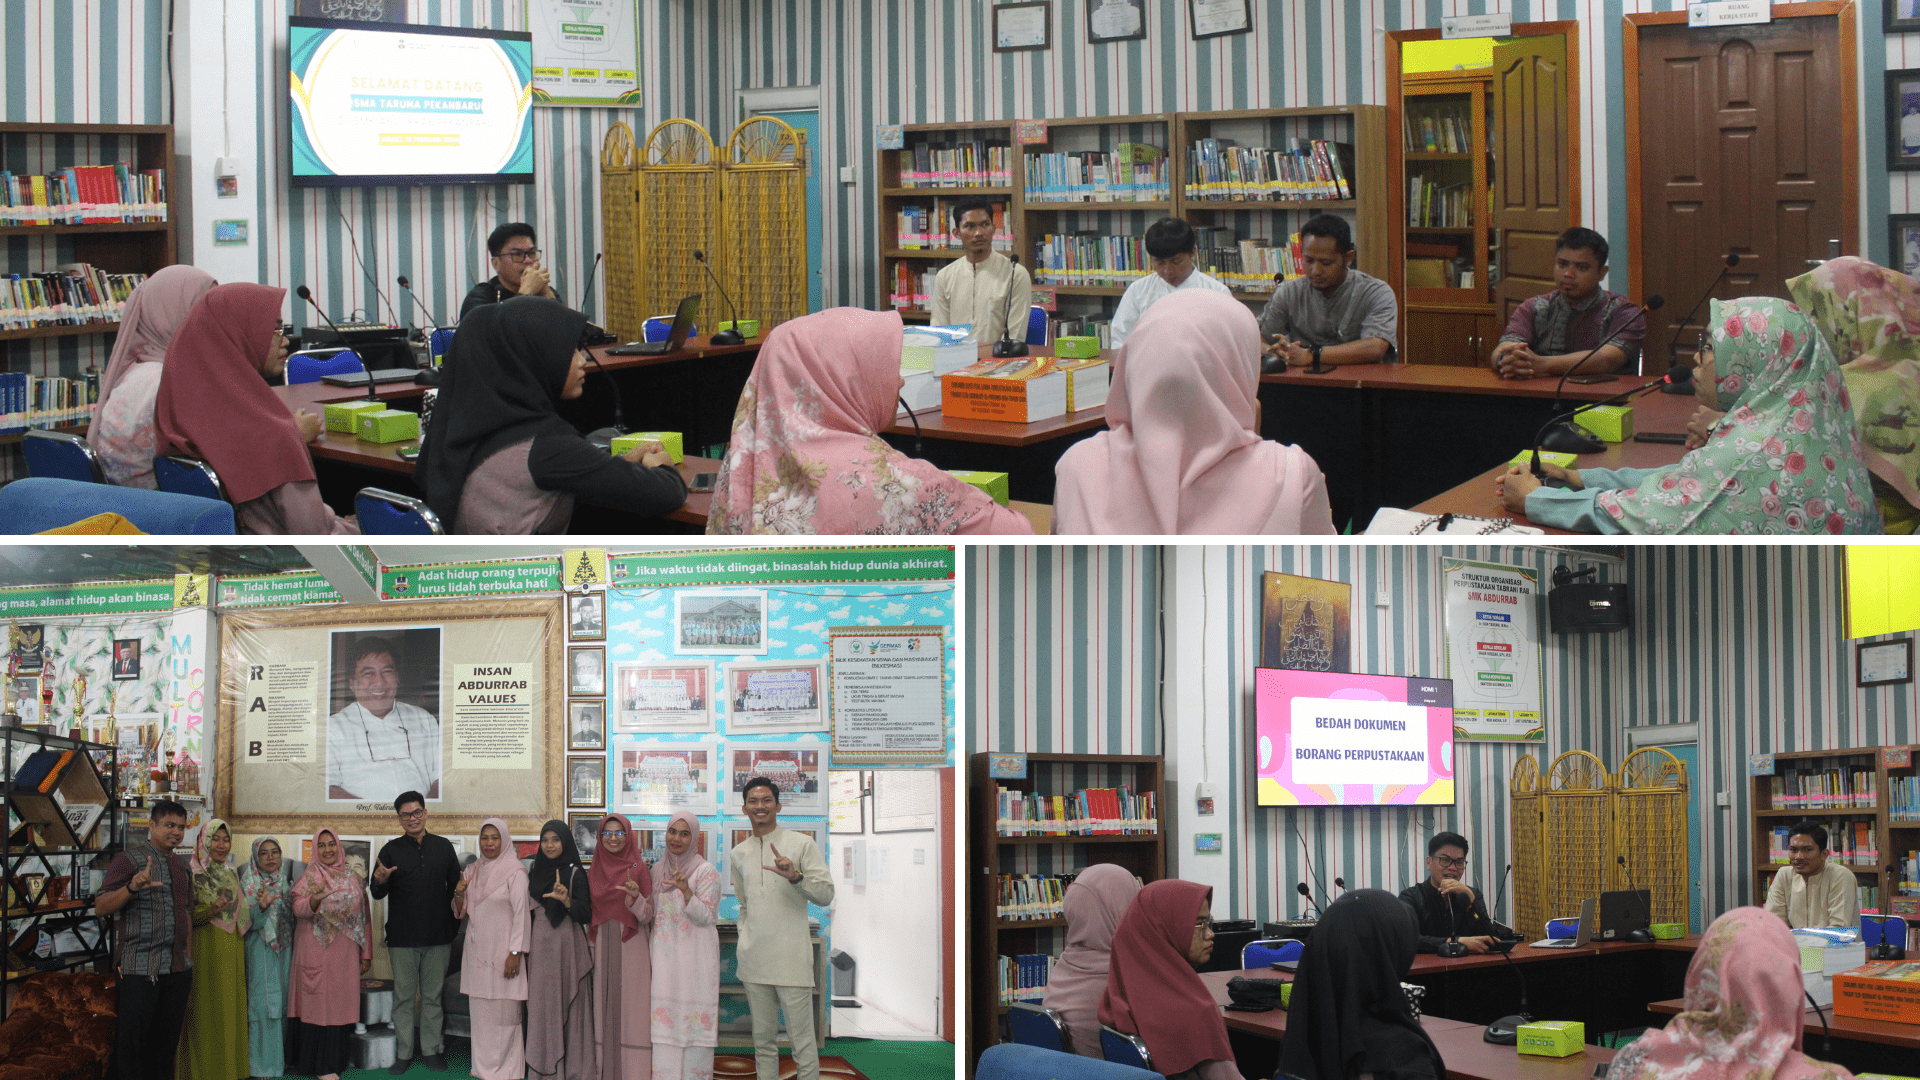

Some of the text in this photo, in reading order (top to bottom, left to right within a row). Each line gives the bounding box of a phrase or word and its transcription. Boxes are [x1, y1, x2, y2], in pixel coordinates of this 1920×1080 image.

[352, 77, 483, 92] SELAMAT DATANG
[354, 99, 480, 110] SMA TARUNA PEKANBARU
[418, 565, 558, 580] Adat hidup orang terpuji,
[635, 559, 947, 575] Jika waktu tidak diingat, binasalah hidup dunia akhirat.
[243, 582, 269, 591] Tidak
[272, 580, 302, 590] hemat
[418, 579, 547, 594] lurus lidah terbuka hati
[1454, 580, 1495, 591] PERPUSTAKAAN
[1497, 584, 1518, 593] TABRANI
[1462, 573, 1521, 586] STRUKTUR ORGANISASI
[10, 600, 38, 608] masa,
[40, 597, 74, 606] alamat
[77, 595, 106, 606] hidup
[108, 594, 133, 603] akan
[136, 592, 173, 602] binasa.
[241, 590, 340, 604] tidak cermat kiamat.
[1468, 592, 1517, 605] SMK ABDURRAB
[251, 665, 264, 680] R
[474, 667, 512, 676] INSAN
[458, 681, 527, 690] ABDURRAB
[249, 697, 266, 712] A
[469, 695, 516, 704] VALUES
[1316, 717, 1406, 731] BEDAH DOKUMEN
[249, 741, 262, 756] B
[1296, 748, 1424, 761] BORANG PERPUSTAKAAN
